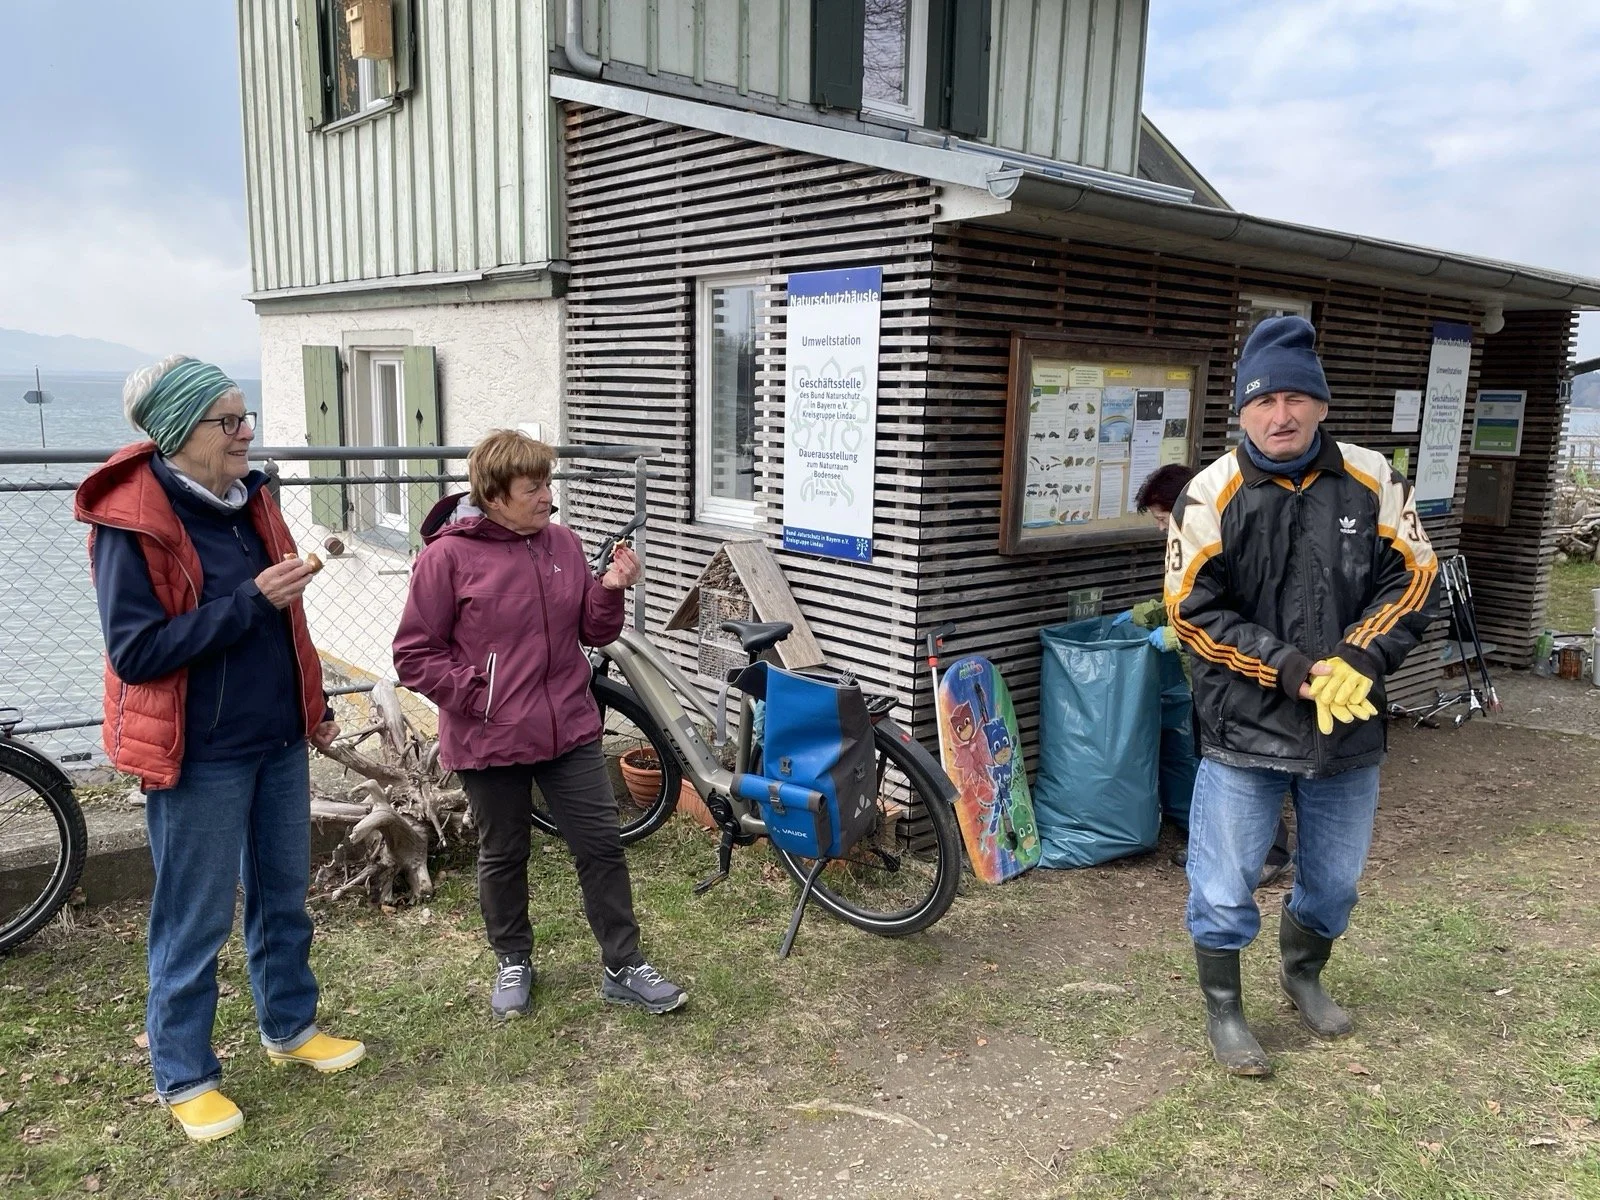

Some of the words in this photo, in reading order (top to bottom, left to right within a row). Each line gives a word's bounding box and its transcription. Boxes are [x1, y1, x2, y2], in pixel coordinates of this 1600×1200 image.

[790, 288, 879, 307] Naturschutzhäusle
[802, 334, 861, 347] Umweltstation
[799, 377, 861, 389] Geschäftsstelle
[826, 392, 860, 400] Naturschutz
[816, 402, 837, 411] Bayern
[802, 410, 836, 420] Kreisgruppe
[836, 410, 857, 420] Lindau
[798, 448, 858, 463] Dauerausstellung
[819, 460, 849, 471] Naturraum
[813, 470, 841, 480] Bodensee
[826, 534, 841, 545] Bayern
[782, 828, 808, 839] VAUDE
